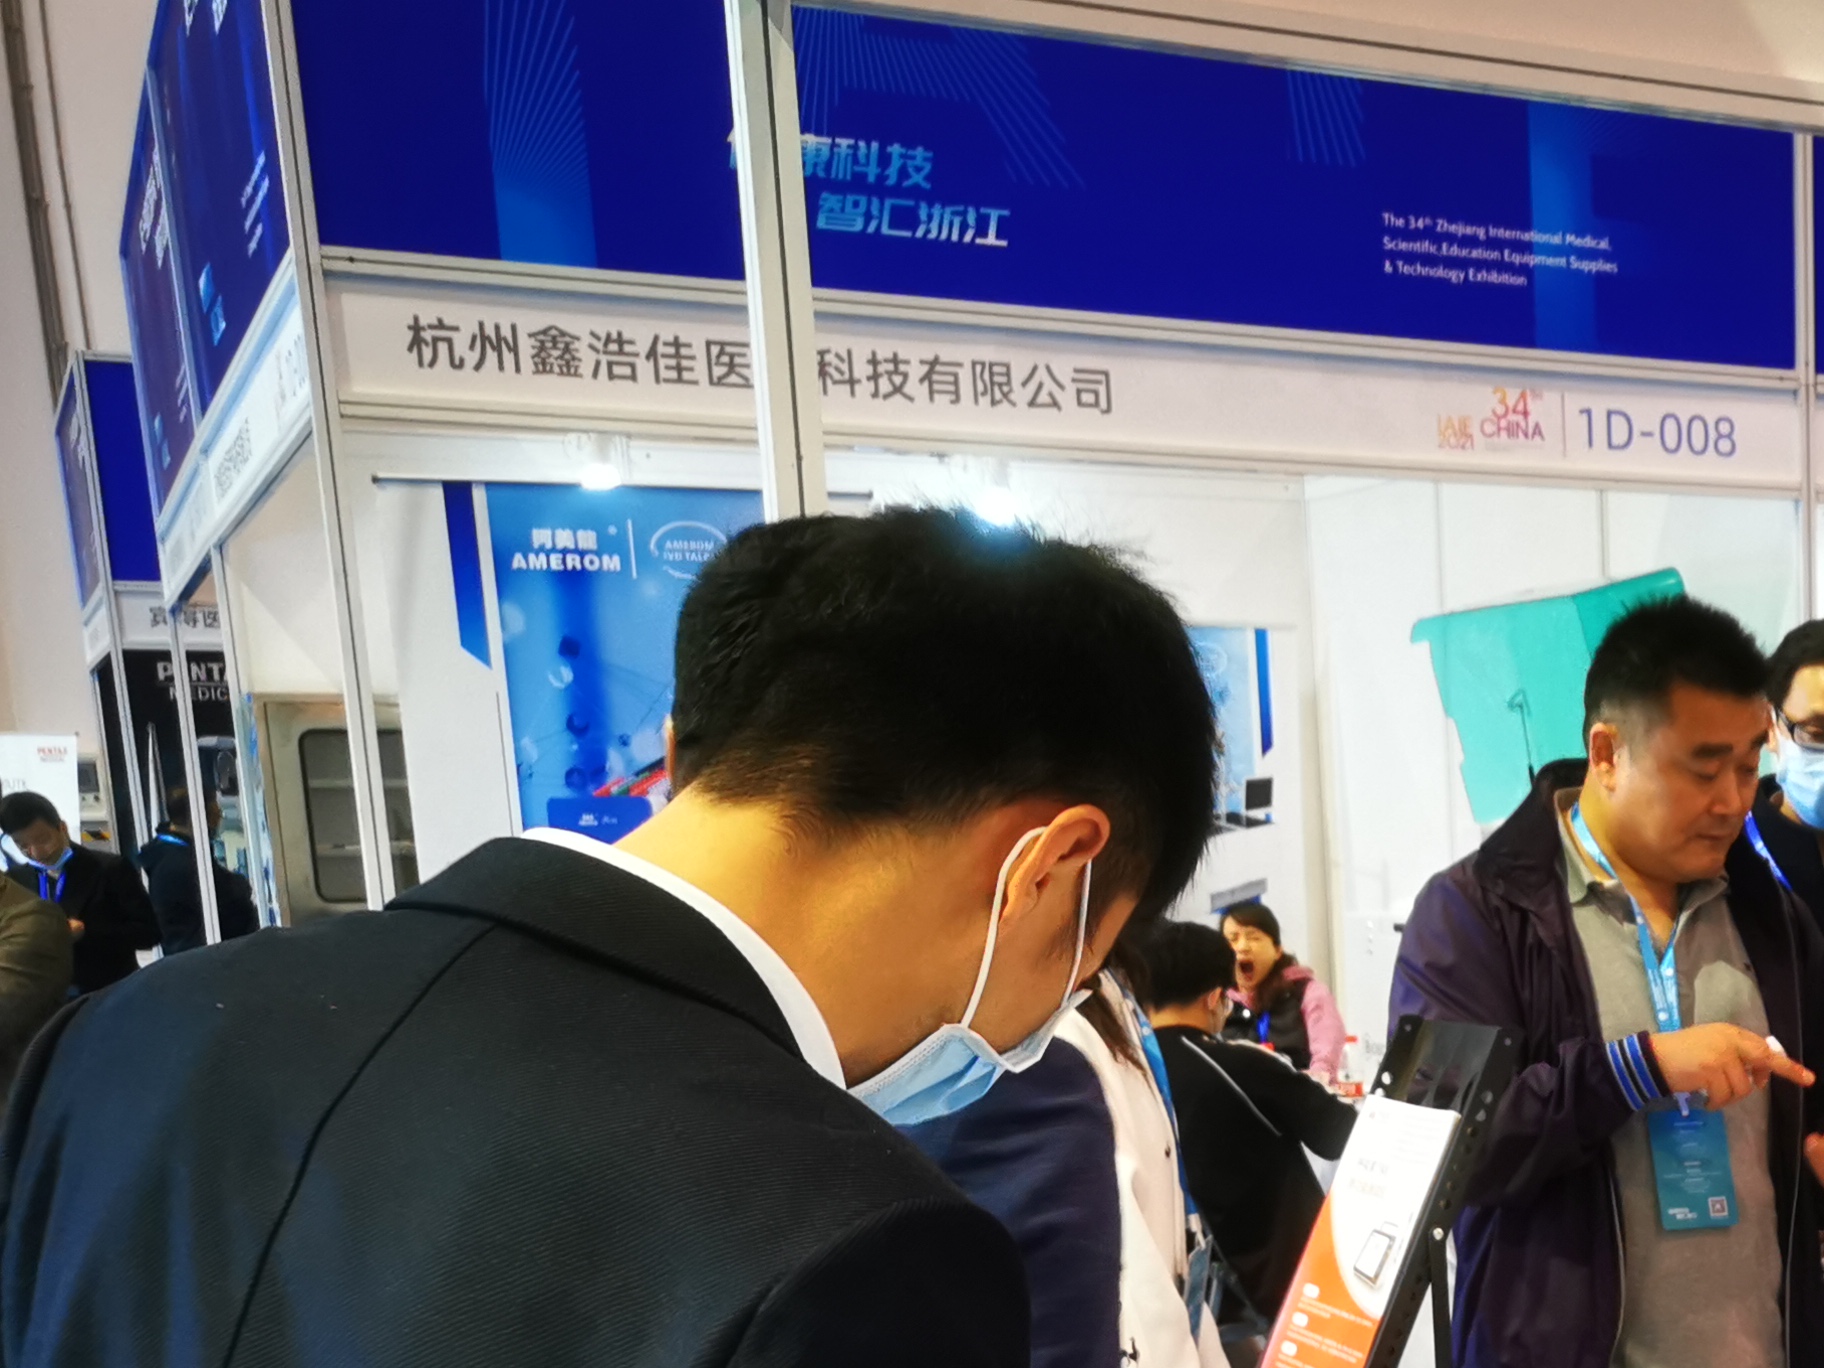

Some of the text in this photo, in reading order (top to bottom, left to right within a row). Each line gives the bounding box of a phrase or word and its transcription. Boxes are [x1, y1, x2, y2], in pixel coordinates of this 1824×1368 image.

[727, 130, 933, 190] 康科技
[816, 191, 1010, 247] 智汇浙江
[1382, 212, 1405, 228] The
[1436, 218, 1487, 240] Zhejiang
[1489, 224, 1562, 245] International
[1396, 261, 1466, 284] Technology
[1468, 268, 1528, 286] Exhibition
[1504, 248, 1567, 269] Equipment
[1570, 256, 1618, 274] Supplies
[407, 315, 1114, 415] 杭州鑫浩佳医科技有限公司
[1480, 417, 1545, 442] CHINA
[1579, 407, 1737, 458] 1D-008
[511, 552, 622, 572] AMEROM
